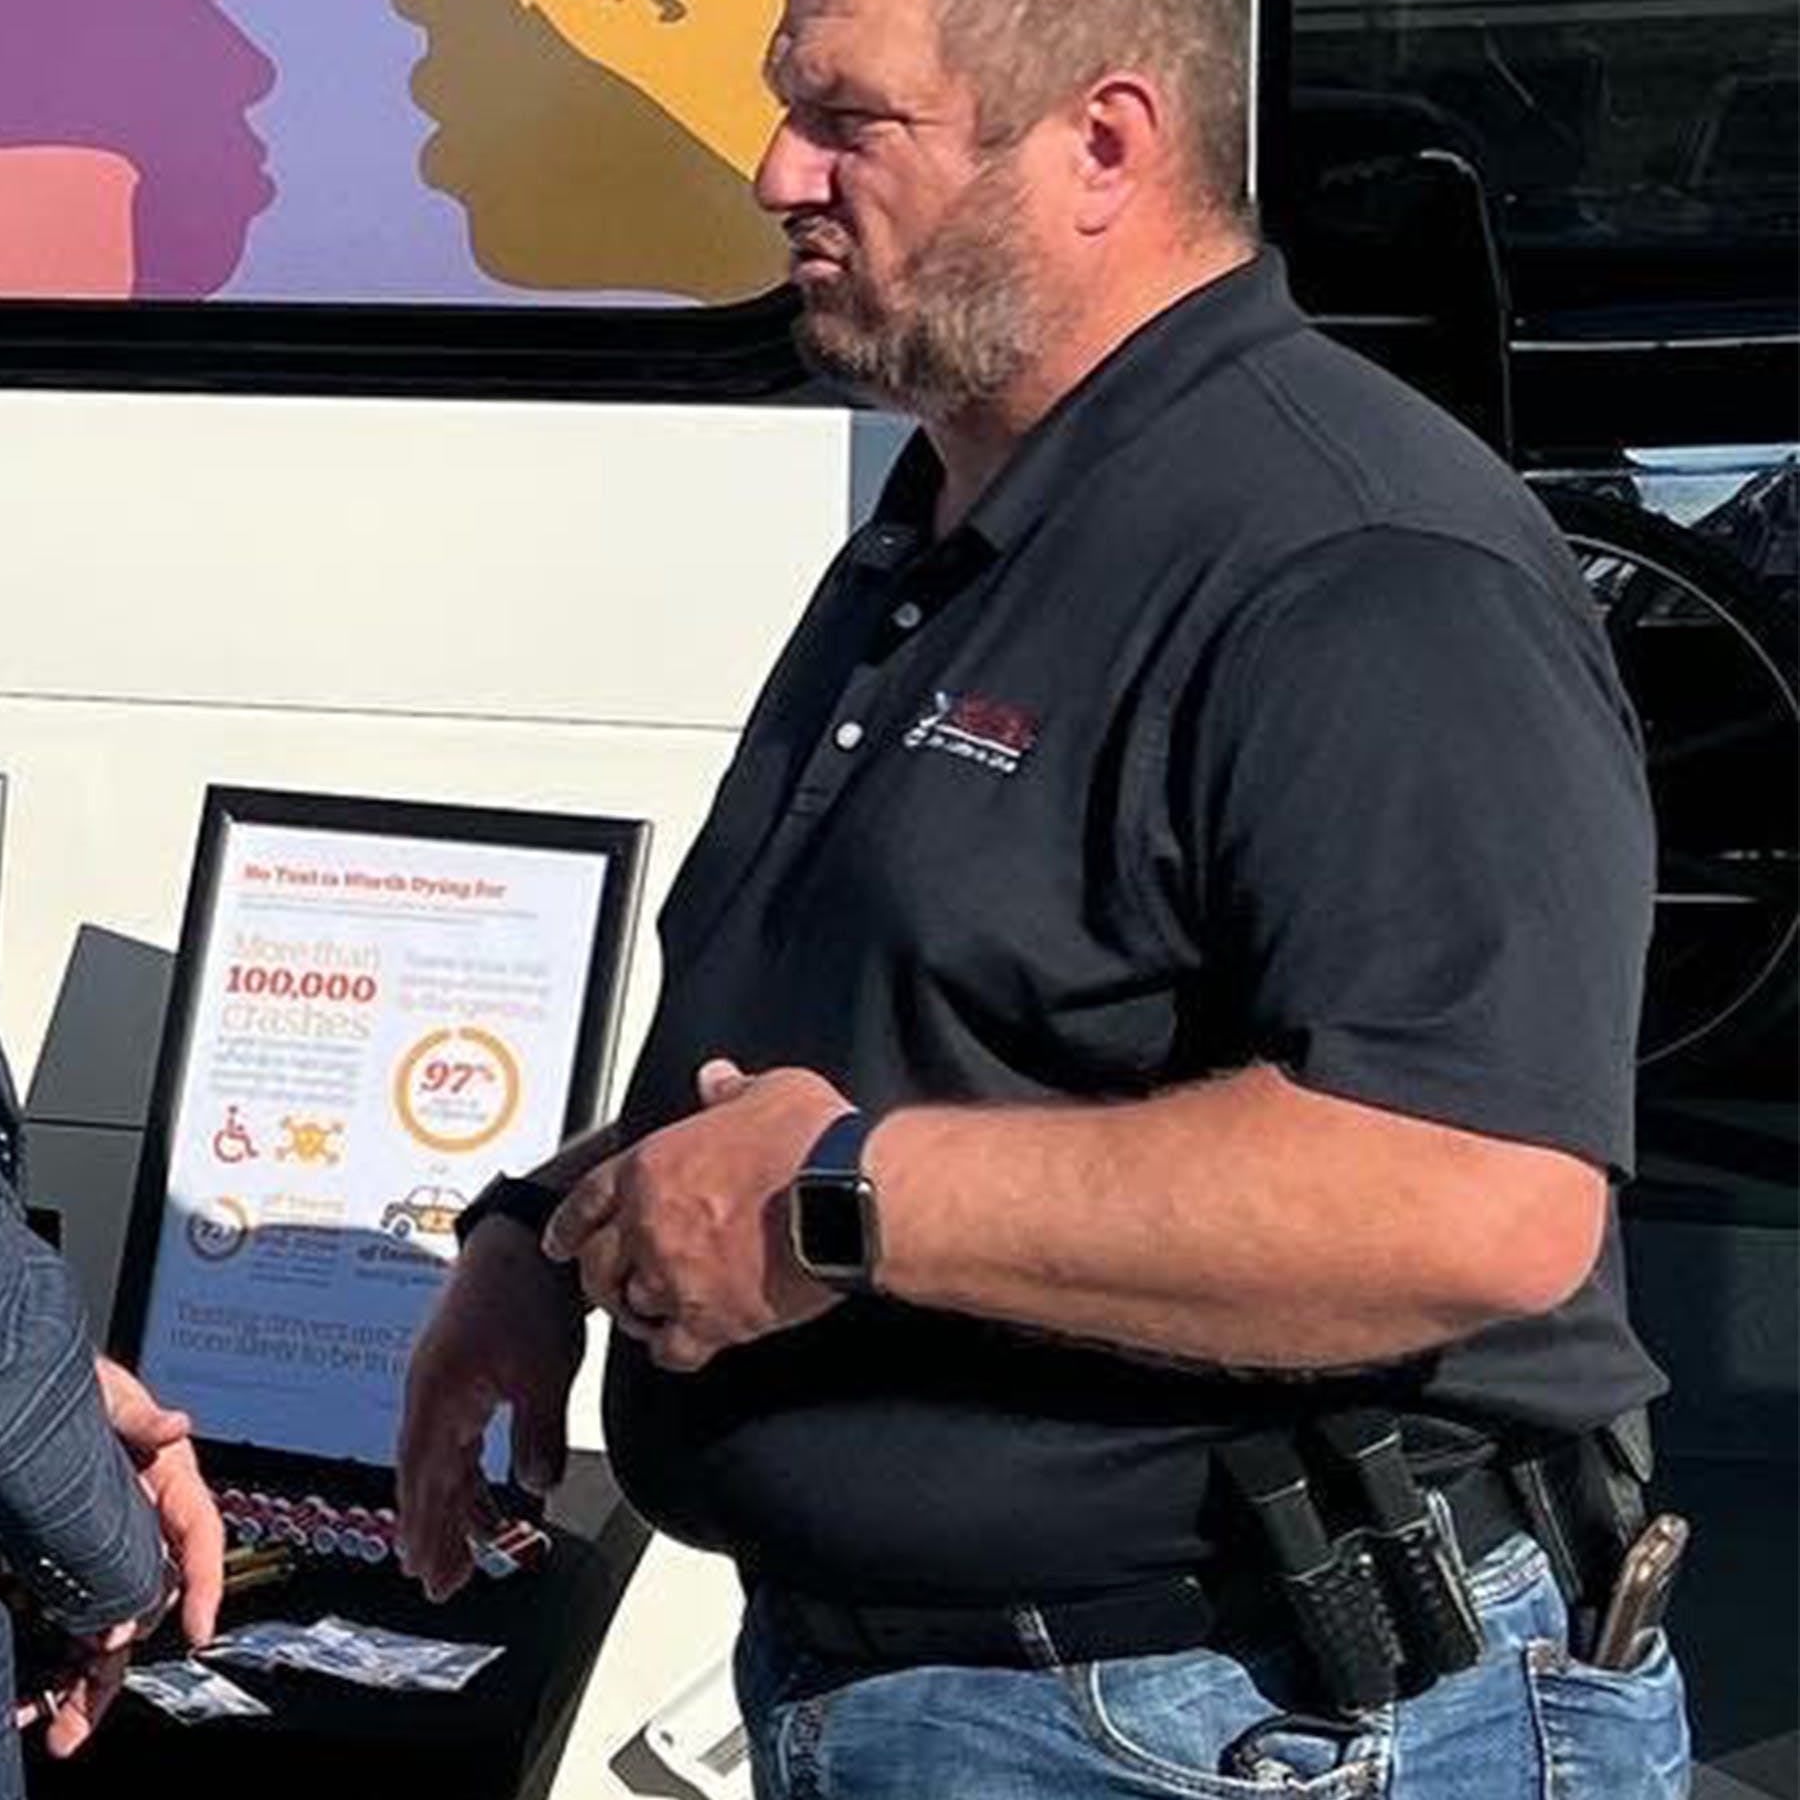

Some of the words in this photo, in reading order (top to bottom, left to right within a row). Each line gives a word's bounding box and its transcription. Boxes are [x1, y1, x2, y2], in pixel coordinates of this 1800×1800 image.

[343, 871, 409, 892] Worth
[411, 876, 473, 900] Dying
[225, 964, 379, 1004] 100,000
[221, 1001, 372, 1041] crashes
